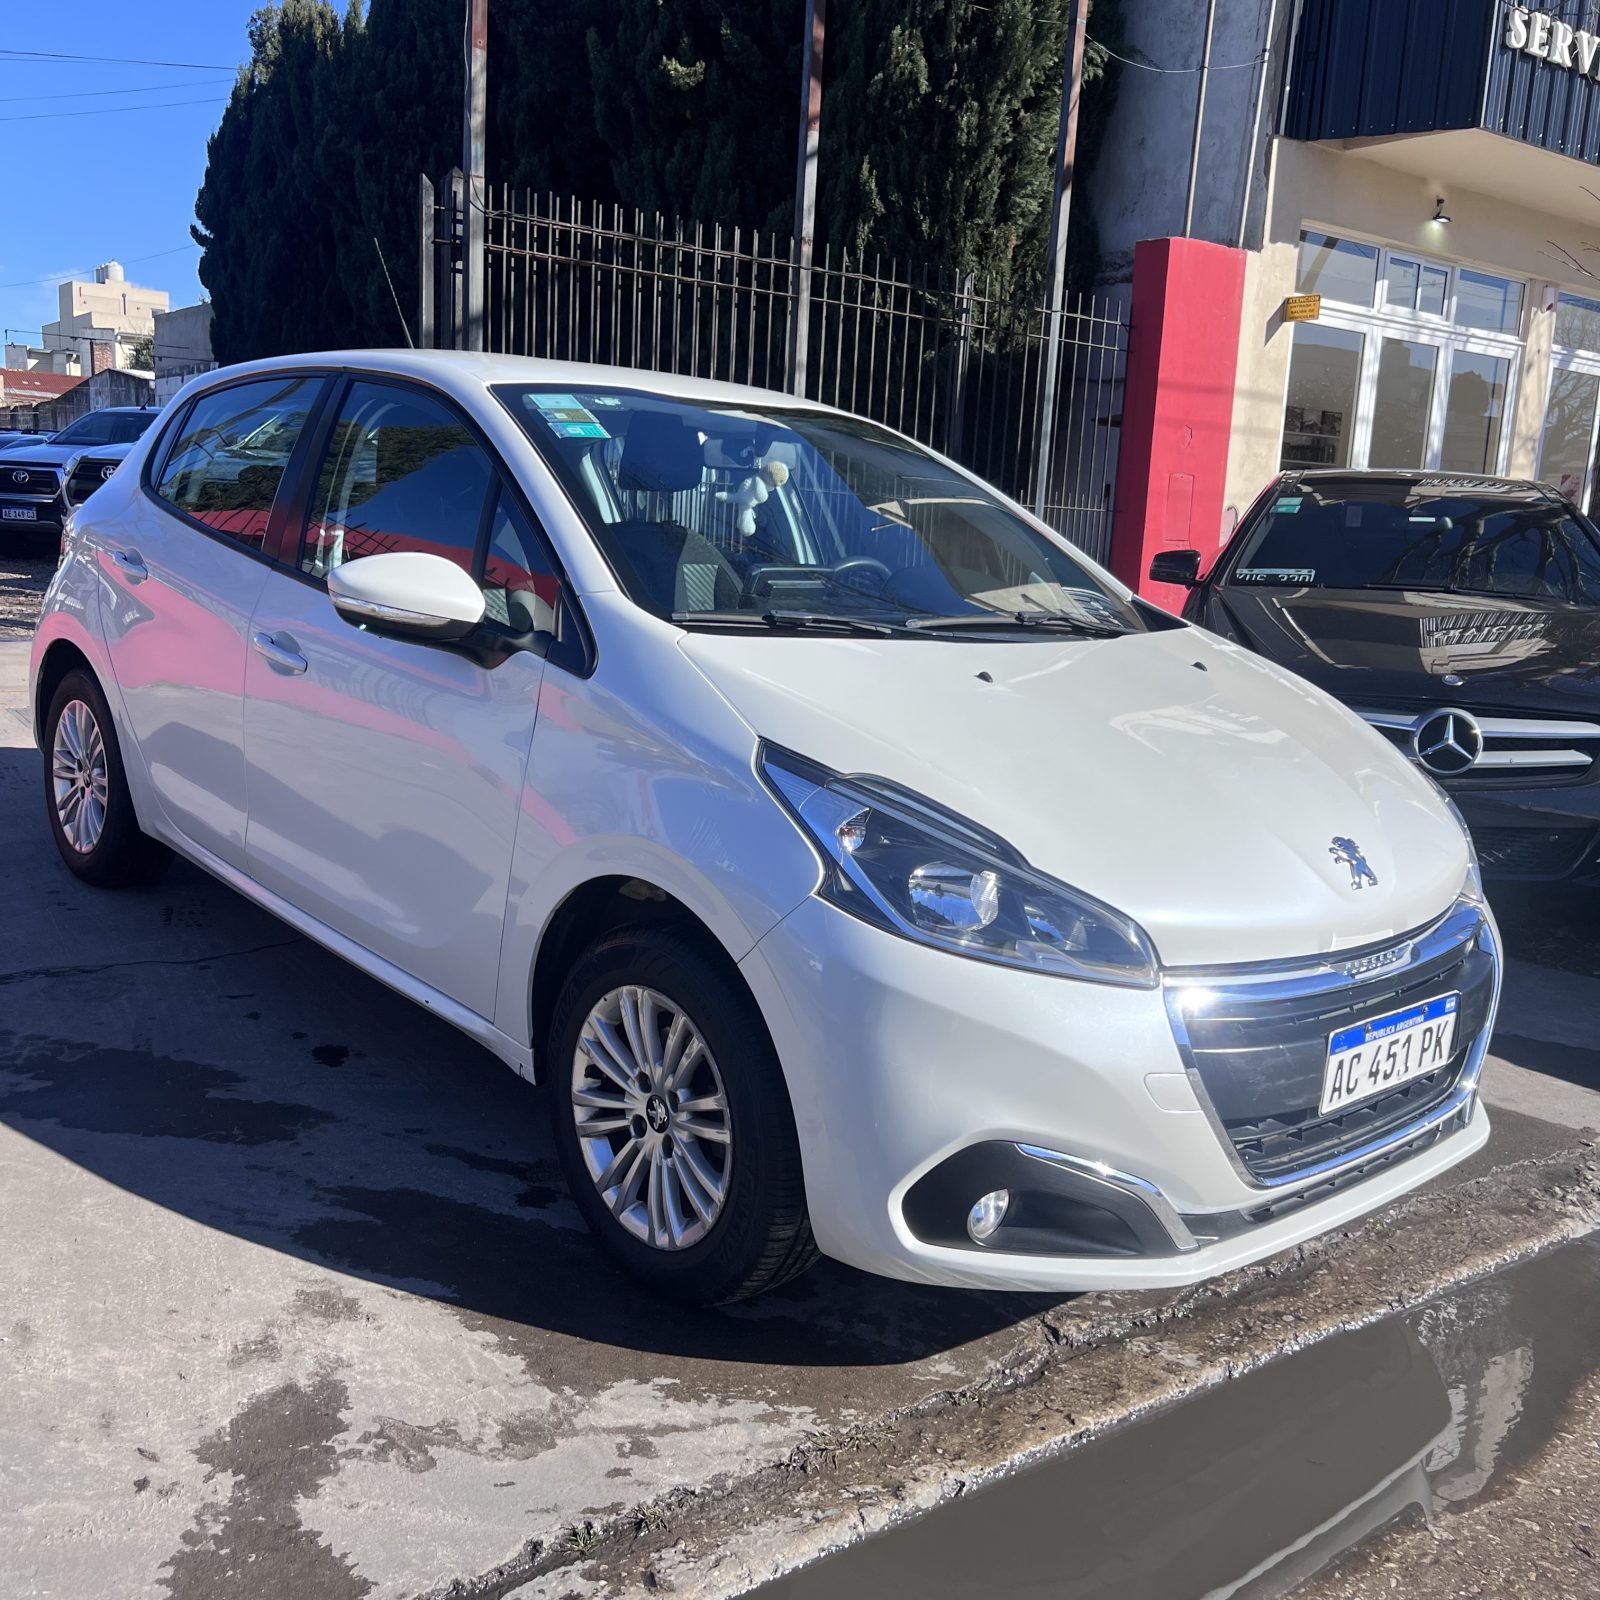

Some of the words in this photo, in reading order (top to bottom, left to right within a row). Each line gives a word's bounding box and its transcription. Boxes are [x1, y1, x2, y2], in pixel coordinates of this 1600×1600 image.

[1505, 5, 1600, 82] SERV
[1330, 1052, 1362, 1103] AC
[1368, 1034, 1412, 1086] 451
[1418, 1019, 1449, 1068] PK
[1365, 1025, 1395, 1042] REPUBLICA
[1396, 1015, 1424, 1031] ARGENTINA
